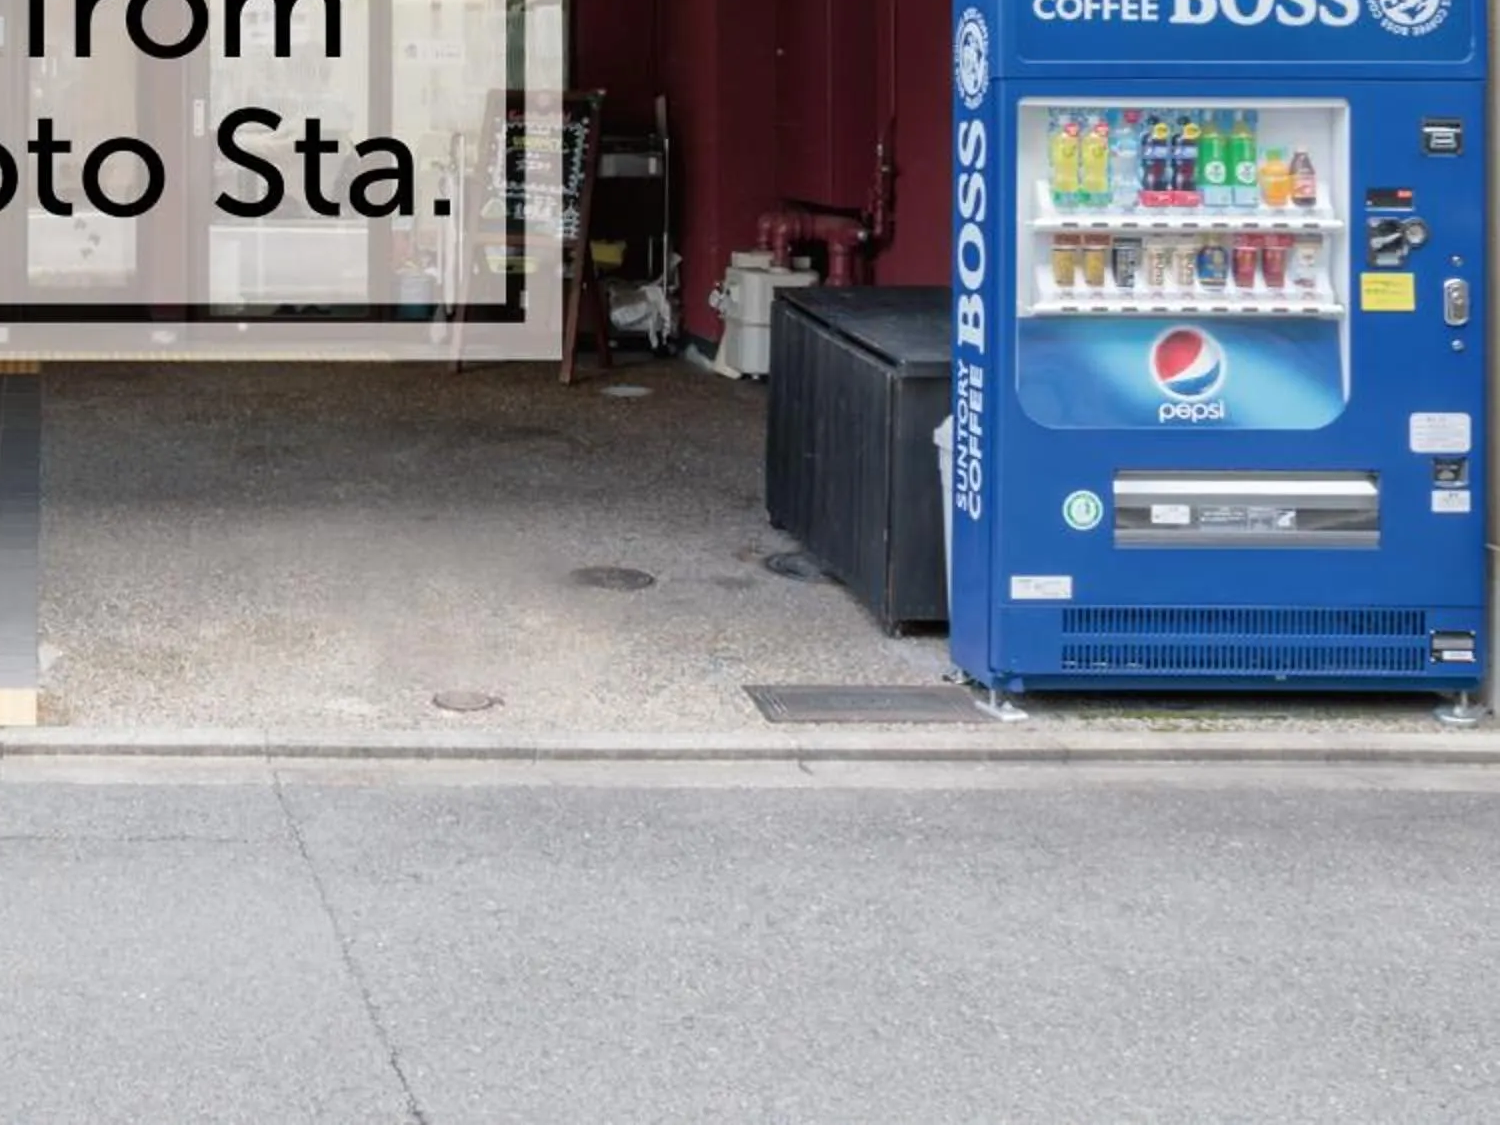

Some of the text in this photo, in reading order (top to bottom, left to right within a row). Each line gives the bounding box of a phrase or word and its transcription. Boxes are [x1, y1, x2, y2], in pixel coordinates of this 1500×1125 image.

[957, 119, 987, 354] BOSS
[956, 358, 969, 512] SUNTORY
[968, 363, 984, 521] COFFEE
[1158, 400, 1226, 423] pepsi
